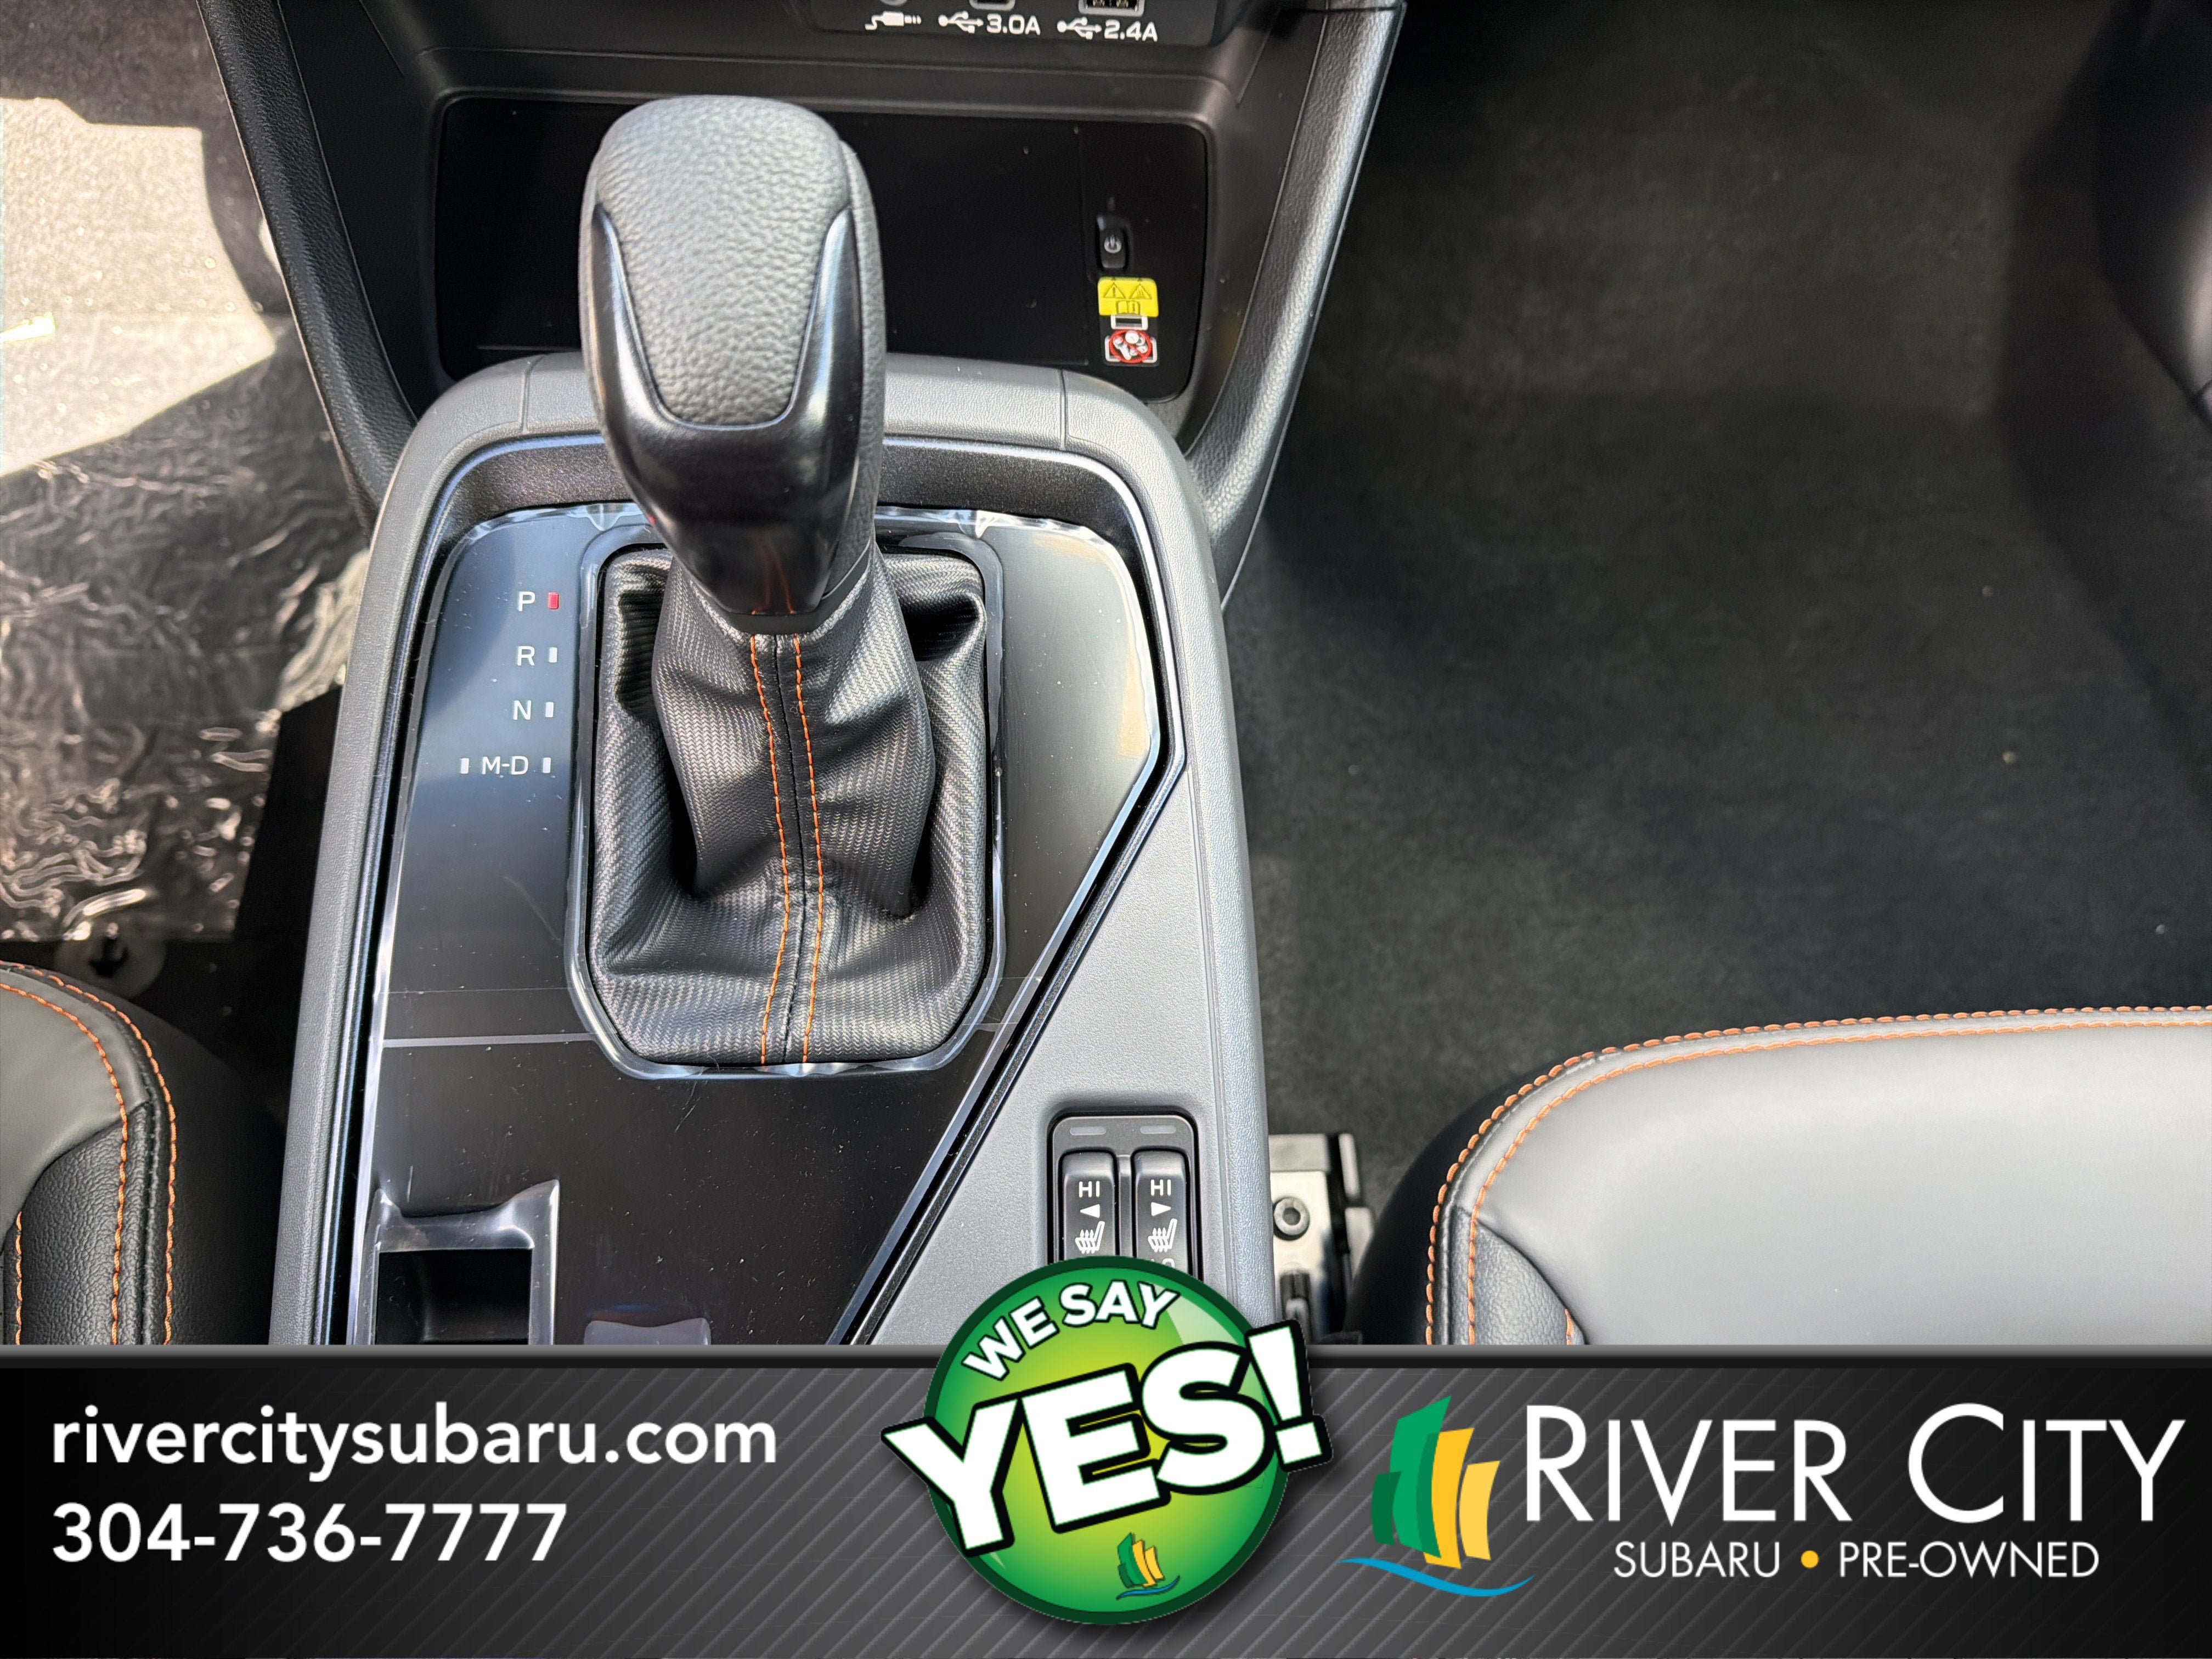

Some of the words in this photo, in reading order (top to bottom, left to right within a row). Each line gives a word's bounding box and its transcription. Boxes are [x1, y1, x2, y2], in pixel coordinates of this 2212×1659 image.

[986, 13, 1041, 36] 3.0A
[1103, 19, 1159, 43] 2.4A
[517, 591, 536, 612] P
[516, 645, 535, 667] R
[512, 699, 532, 721] N
[481, 755, 529, 776] M-D
[1078, 1181, 1101, 1198] HI
[1150, 1179, 1172, 1197] HI
